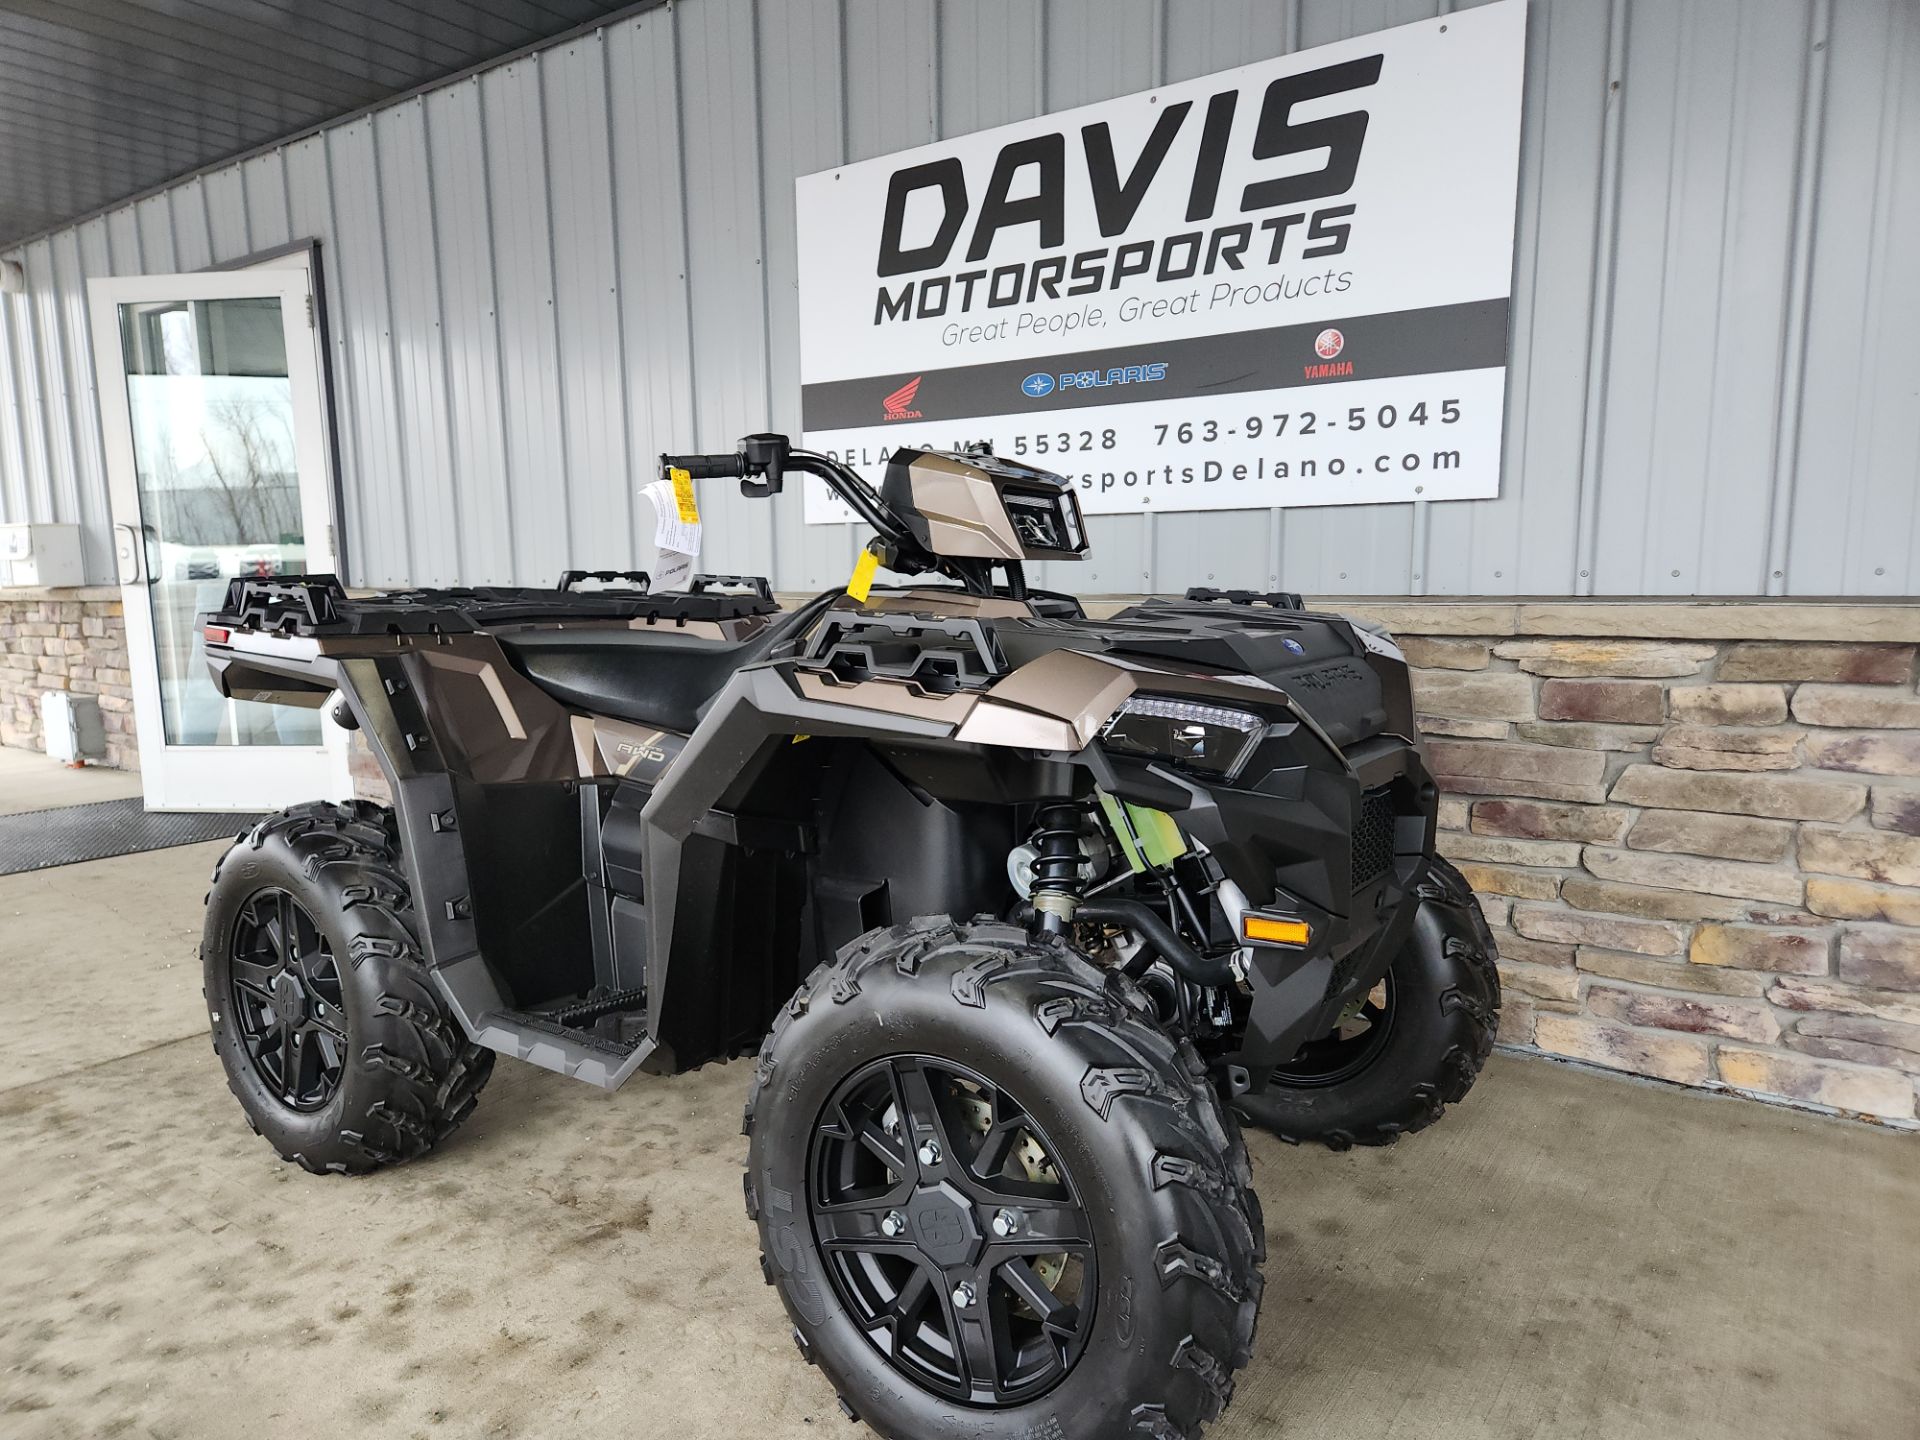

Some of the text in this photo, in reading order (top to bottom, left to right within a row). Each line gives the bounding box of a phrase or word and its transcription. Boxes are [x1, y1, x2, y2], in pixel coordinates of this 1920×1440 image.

[877, 54, 1384, 278] DAVIS
[874, 203, 1357, 326] MOTORSPORTS
[942, 269, 1353, 346] Great People, Great Products
[1059, 363, 1166, 391] POLARIS
[1304, 361, 1354, 380] YAMAHA
[826, 443, 934, 467] DELA
[1014, 429, 1117, 455] 55328
[1154, 399, 1461, 446] 763-972-5045
[883, 410, 923, 421] HONDA
[617, 743, 665, 762] AWD
[763, 1170, 826, 1326] CST
